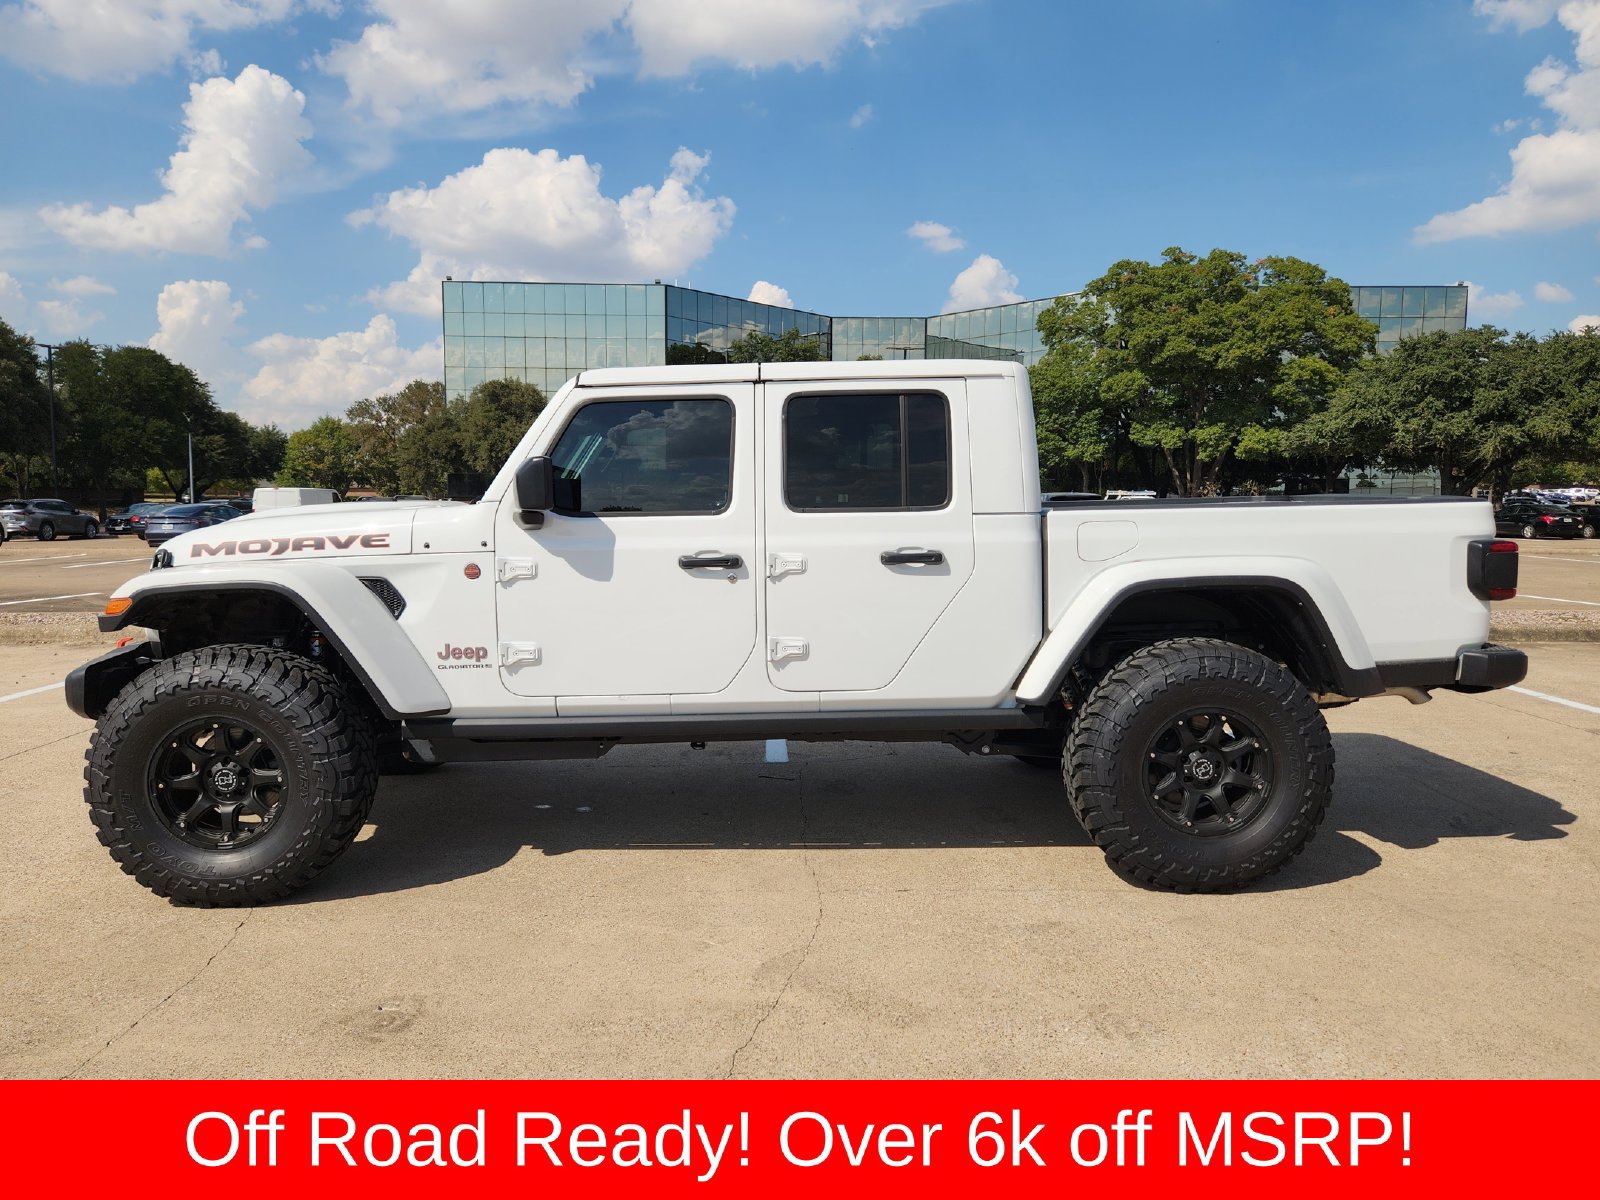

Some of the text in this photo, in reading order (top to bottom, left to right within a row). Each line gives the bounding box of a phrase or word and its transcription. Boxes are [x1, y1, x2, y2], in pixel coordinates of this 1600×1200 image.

[190, 533, 390, 558] MOJAVE
[437, 643, 488, 662] Jeep
[185, 694, 312, 809] OPEN COUNTRY
[146, 841, 218, 877] TOYO
